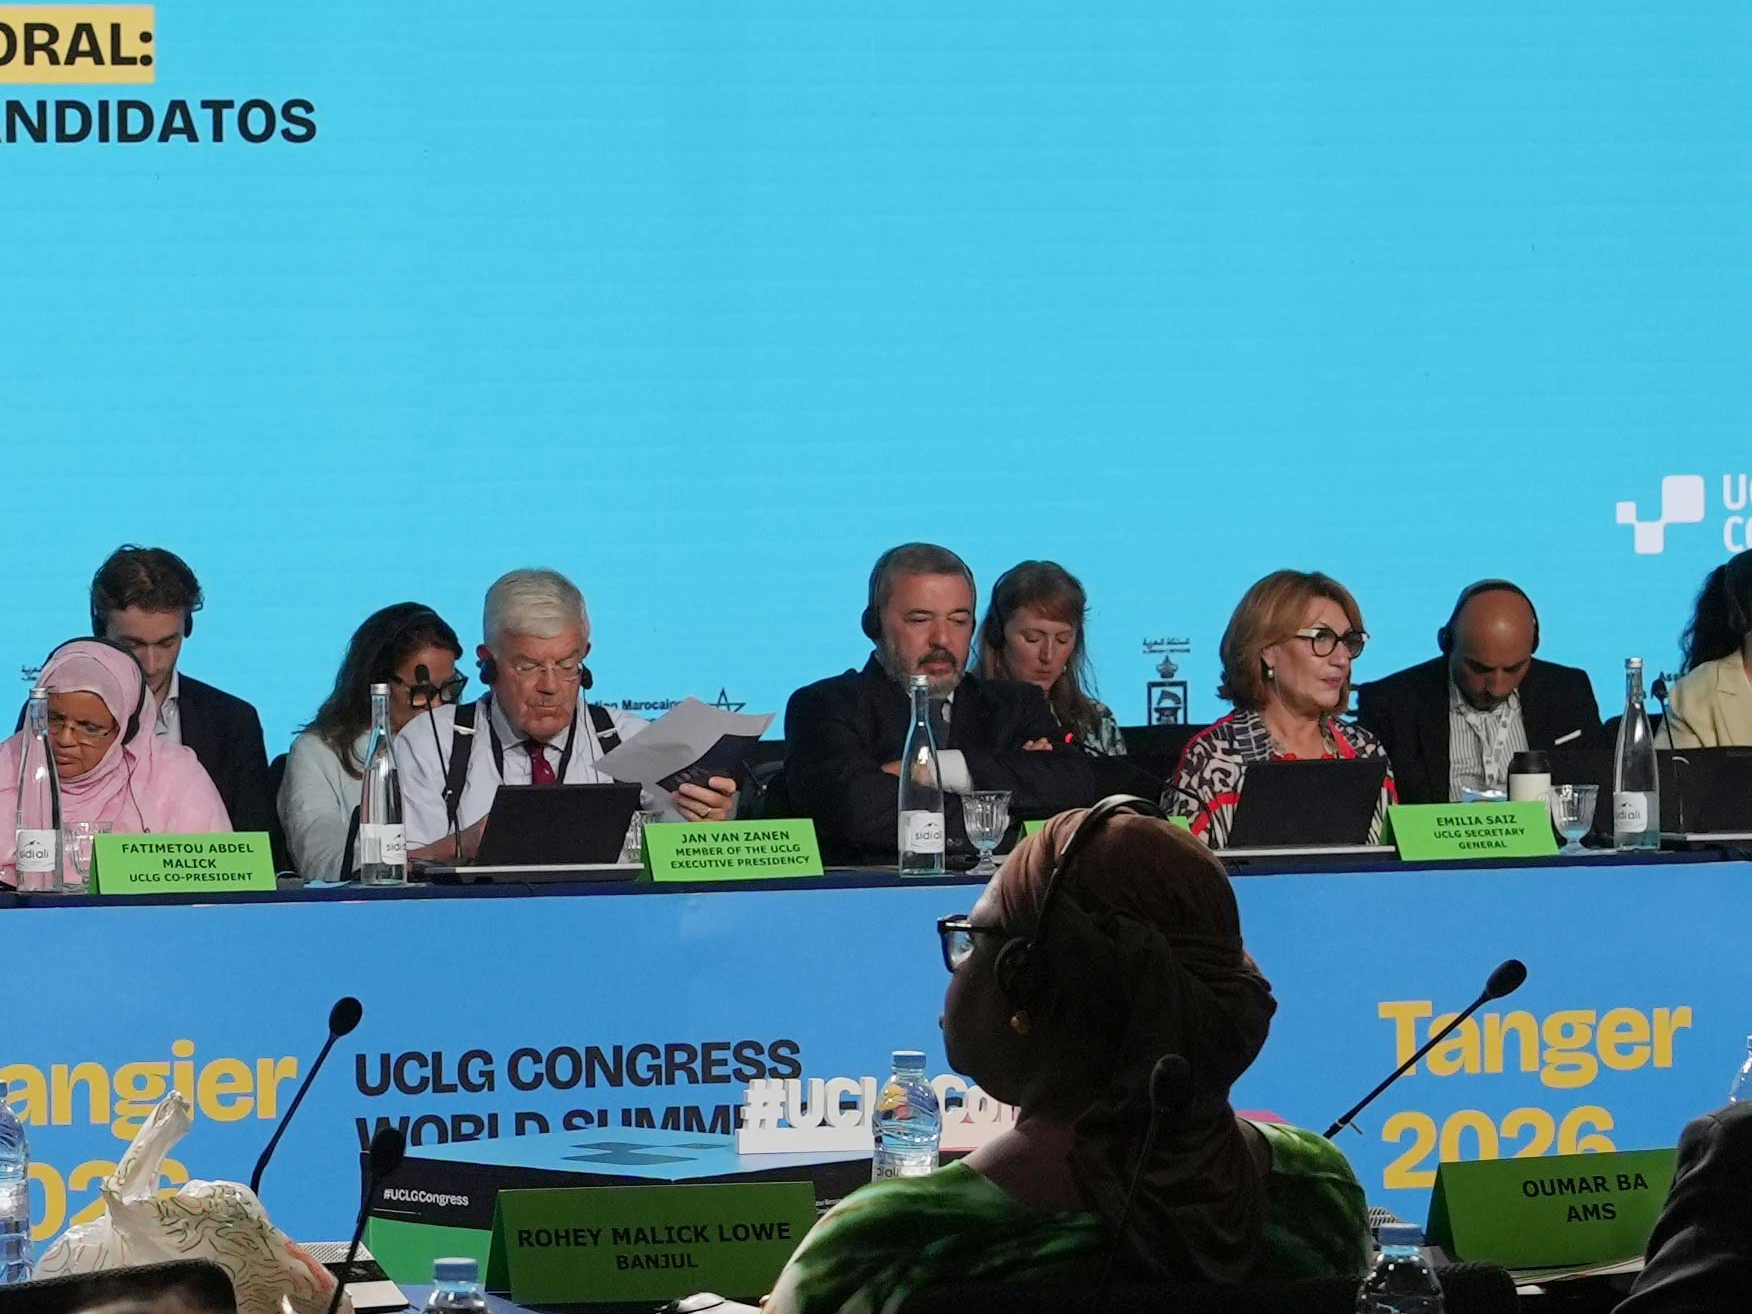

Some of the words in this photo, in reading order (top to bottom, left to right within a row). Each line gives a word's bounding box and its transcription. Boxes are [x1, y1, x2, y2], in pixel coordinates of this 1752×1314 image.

[1436, 816, 1482, 827] EMILIA
[1486, 814, 1517, 825] SAIZ
[681, 833, 706, 844] JAN
[712, 832, 739, 843] VAN
[744, 831, 789, 842] ZANEN
[1433, 829, 1462, 839] UCLG
[1465, 827, 1526, 838] SECRETARY
[121, 843, 203, 854] FATIMETOU
[209, 843, 254, 853] ABDEL
[676, 846, 724, 857] MEMBER
[727, 846, 742, 855] OF
[745, 845, 768, 855] THE
[770, 843, 801, 854] UCLG
[1458, 839, 1508, 850] GENERAL
[163, 858, 216, 869] MALICK
[671, 858, 733, 869] EXECUTIVE
[738, 855, 810, 867] PRESIDENCY
[129, 873, 161, 883] UCLG
[164, 872, 253, 882] CO-PRESIDENT
[1378, 1000, 1692, 1089] Tanger
[355, 1050, 494, 1096] UCLG
[507, 1039, 802, 1090] CONGRESS
[1522, 1175, 1610, 1199] OUMAR
[1618, 1173, 1649, 1193] BA
[383, 1188, 469, 1207] #UCLGCongress
[1566, 1202, 1617, 1223] AMS
[518, 1228, 602, 1248] ROHEY
[612, 1225, 710, 1246] MALICK
[718, 1222, 791, 1243] LOWE
[616, 1253, 699, 1271] BANJUL
